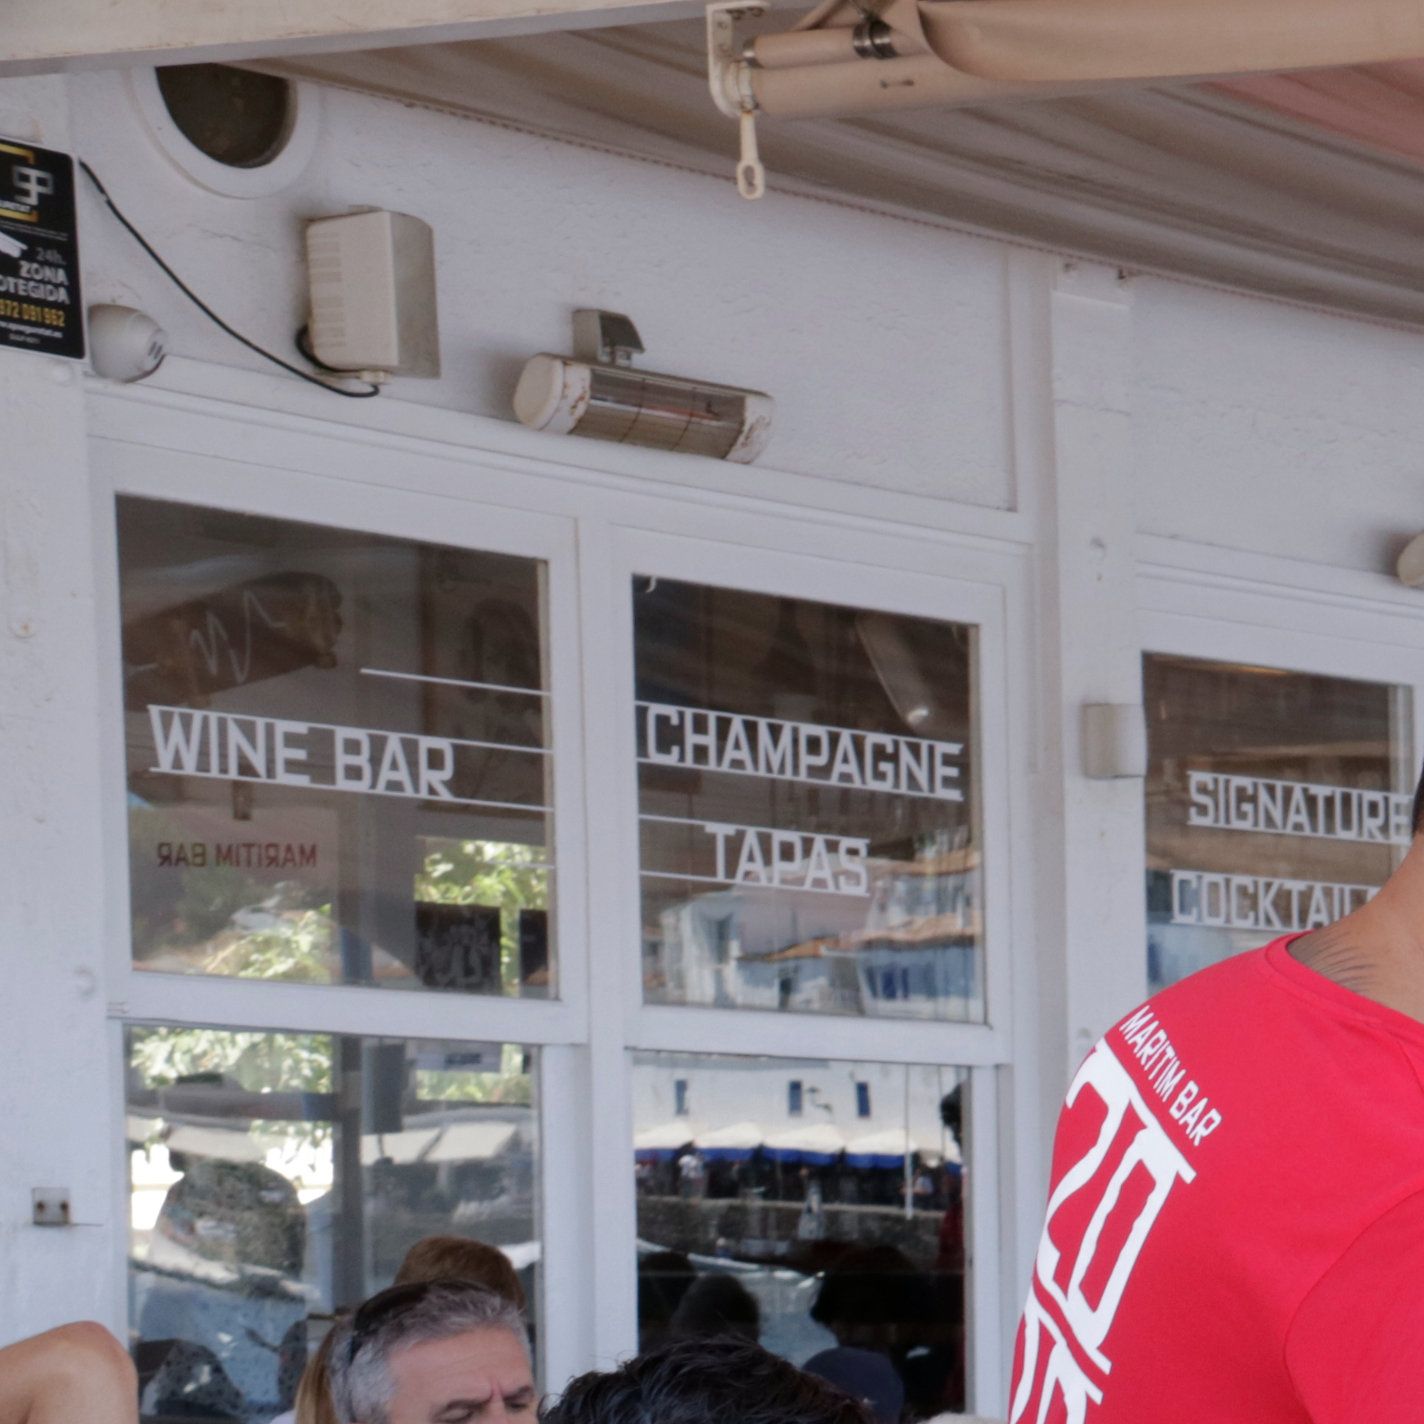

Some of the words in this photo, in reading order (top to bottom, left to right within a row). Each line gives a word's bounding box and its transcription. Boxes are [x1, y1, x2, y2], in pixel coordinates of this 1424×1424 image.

[0, 274, 71, 305] OTEGIDA
[19, 260, 69, 286] ZONA
[148, 705, 311, 786] WINE
[335, 728, 456, 801] BAR
[646, 704, 965, 801] CHAMPAGNE
[1188, 771, 1414, 845] SIGNATURE
[703, 822, 871, 897] TAPAS
[1118, 1004, 1187, 1103] MARITIM
[1168, 1080, 1222, 1147] BAR
